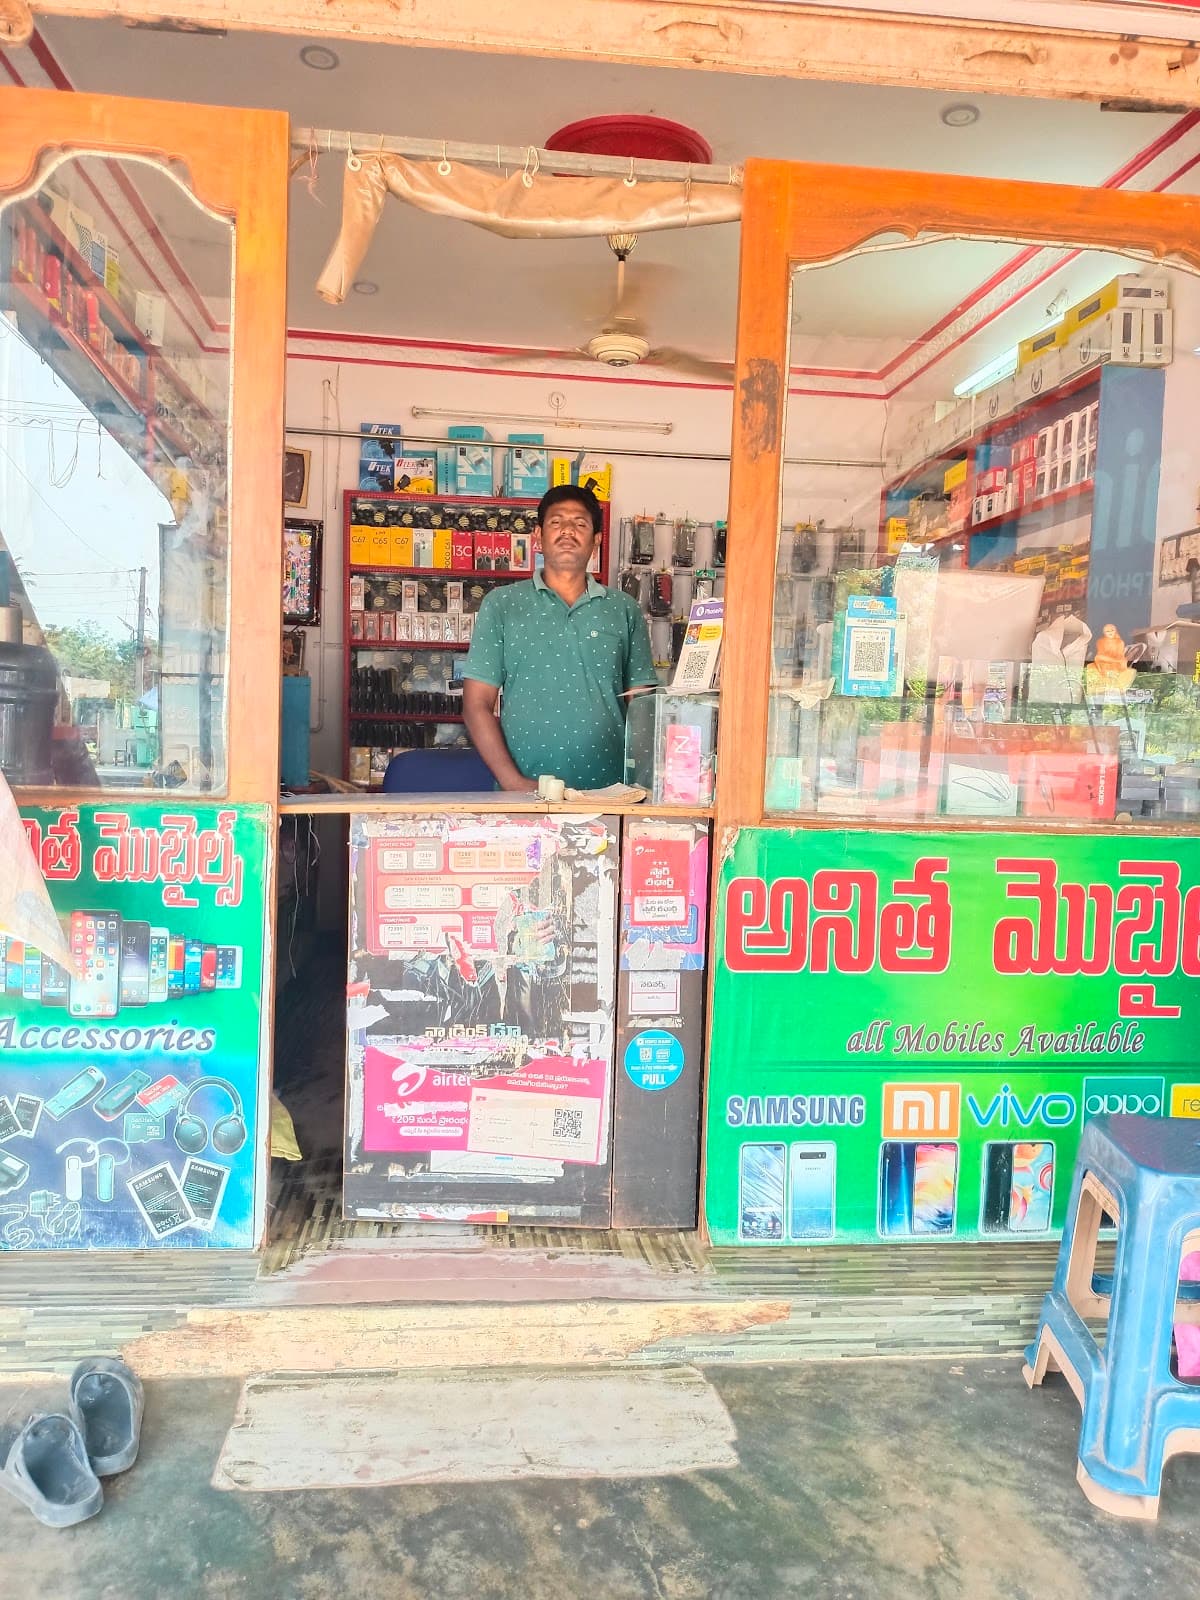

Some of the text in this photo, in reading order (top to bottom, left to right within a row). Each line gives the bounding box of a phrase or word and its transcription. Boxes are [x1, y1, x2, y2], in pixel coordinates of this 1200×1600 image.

[372, 537, 388, 545] C65
[394, 537, 409, 545] C67
[452, 544, 473, 557] 13C
[476, 546, 493, 555] A3x
[494, 547, 511, 556] A3x
[674, 735, 691, 754] Z
[992, 857, 1200, 1018] మొబై
[0, 1017, 217, 1052] Accessories
[846, 1021, 1146, 1057] all Mobiles Available
[432, 1073, 472, 1087] airtel
[642, 1073, 667, 1085] PULL
[728, 1096, 865, 1126] SAMSUNG
[967, 1085, 1076, 1127] vivo
[1085, 1092, 1161, 1117] oppo
[191, 1164, 219, 1178] SAMSUNG
[134, 1172, 164, 1192] SAMSUNG
